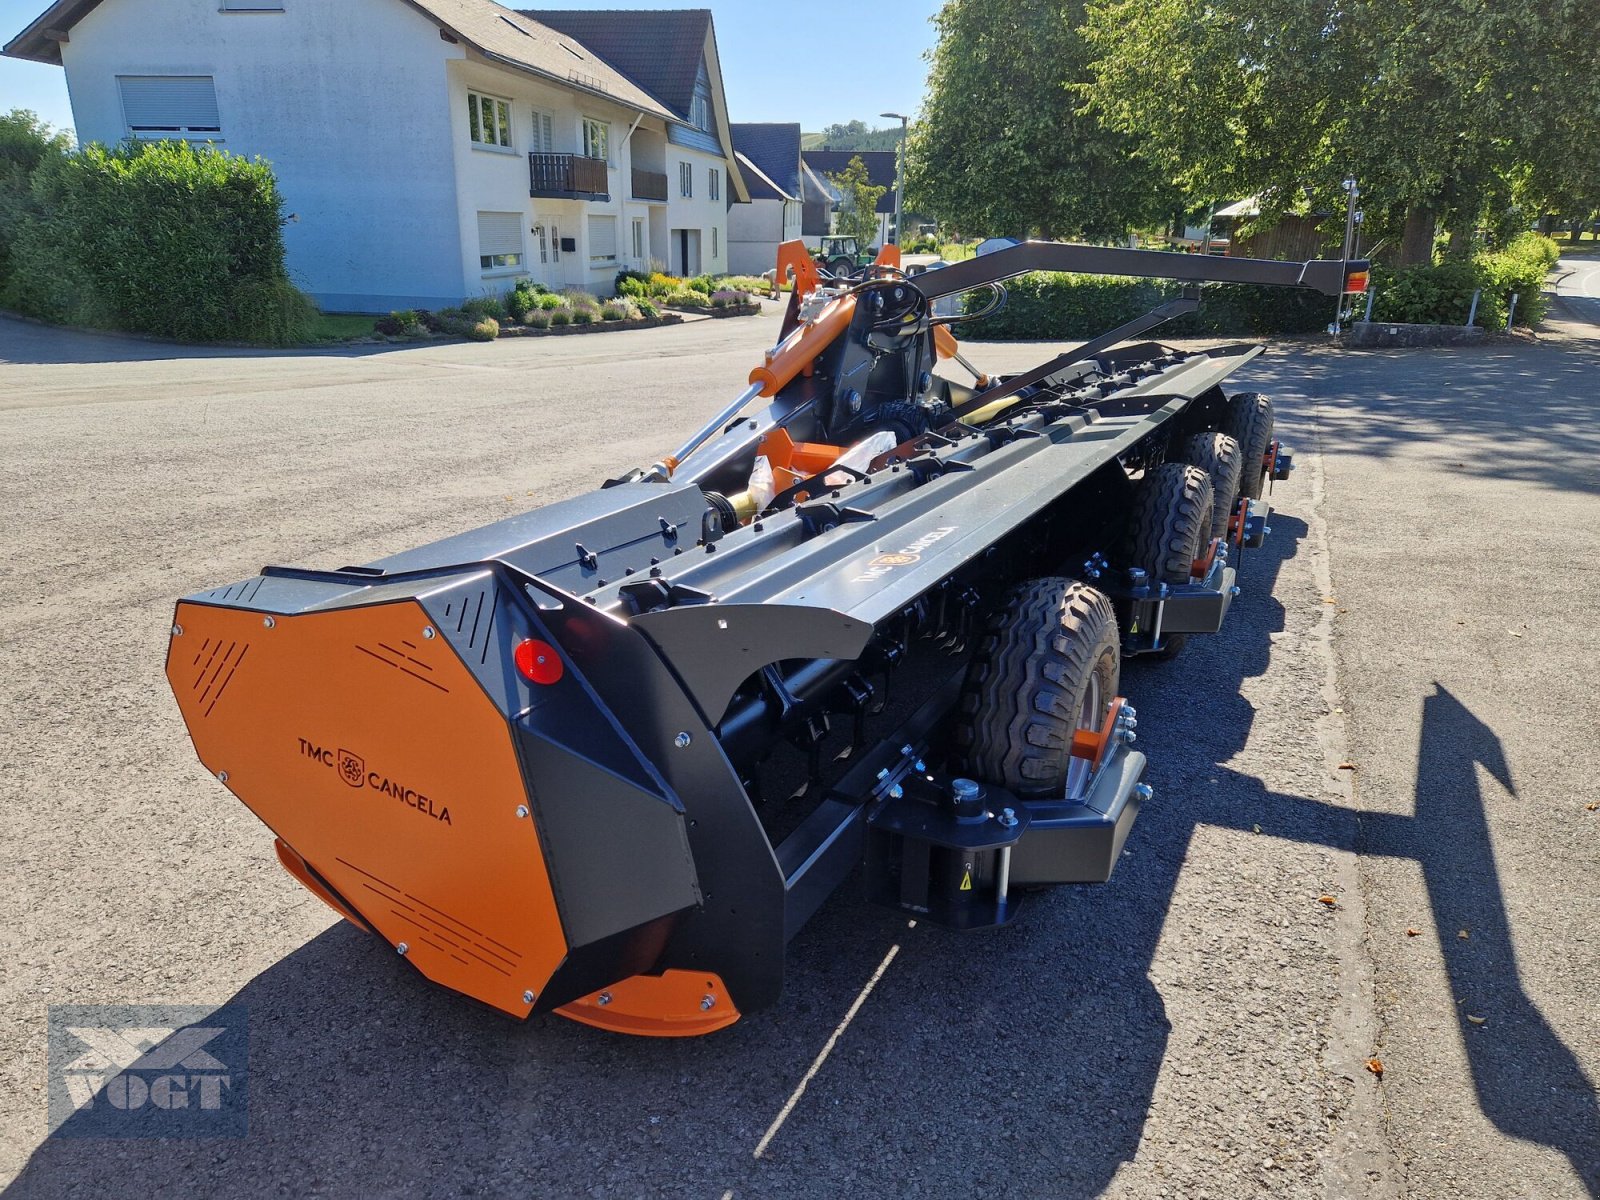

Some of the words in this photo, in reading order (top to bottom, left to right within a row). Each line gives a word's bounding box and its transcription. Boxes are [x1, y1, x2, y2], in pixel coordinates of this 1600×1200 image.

[850, 566, 893, 582] TMC
[298, 737, 334, 767] TMC
[367, 772, 452, 826] CANCELA
